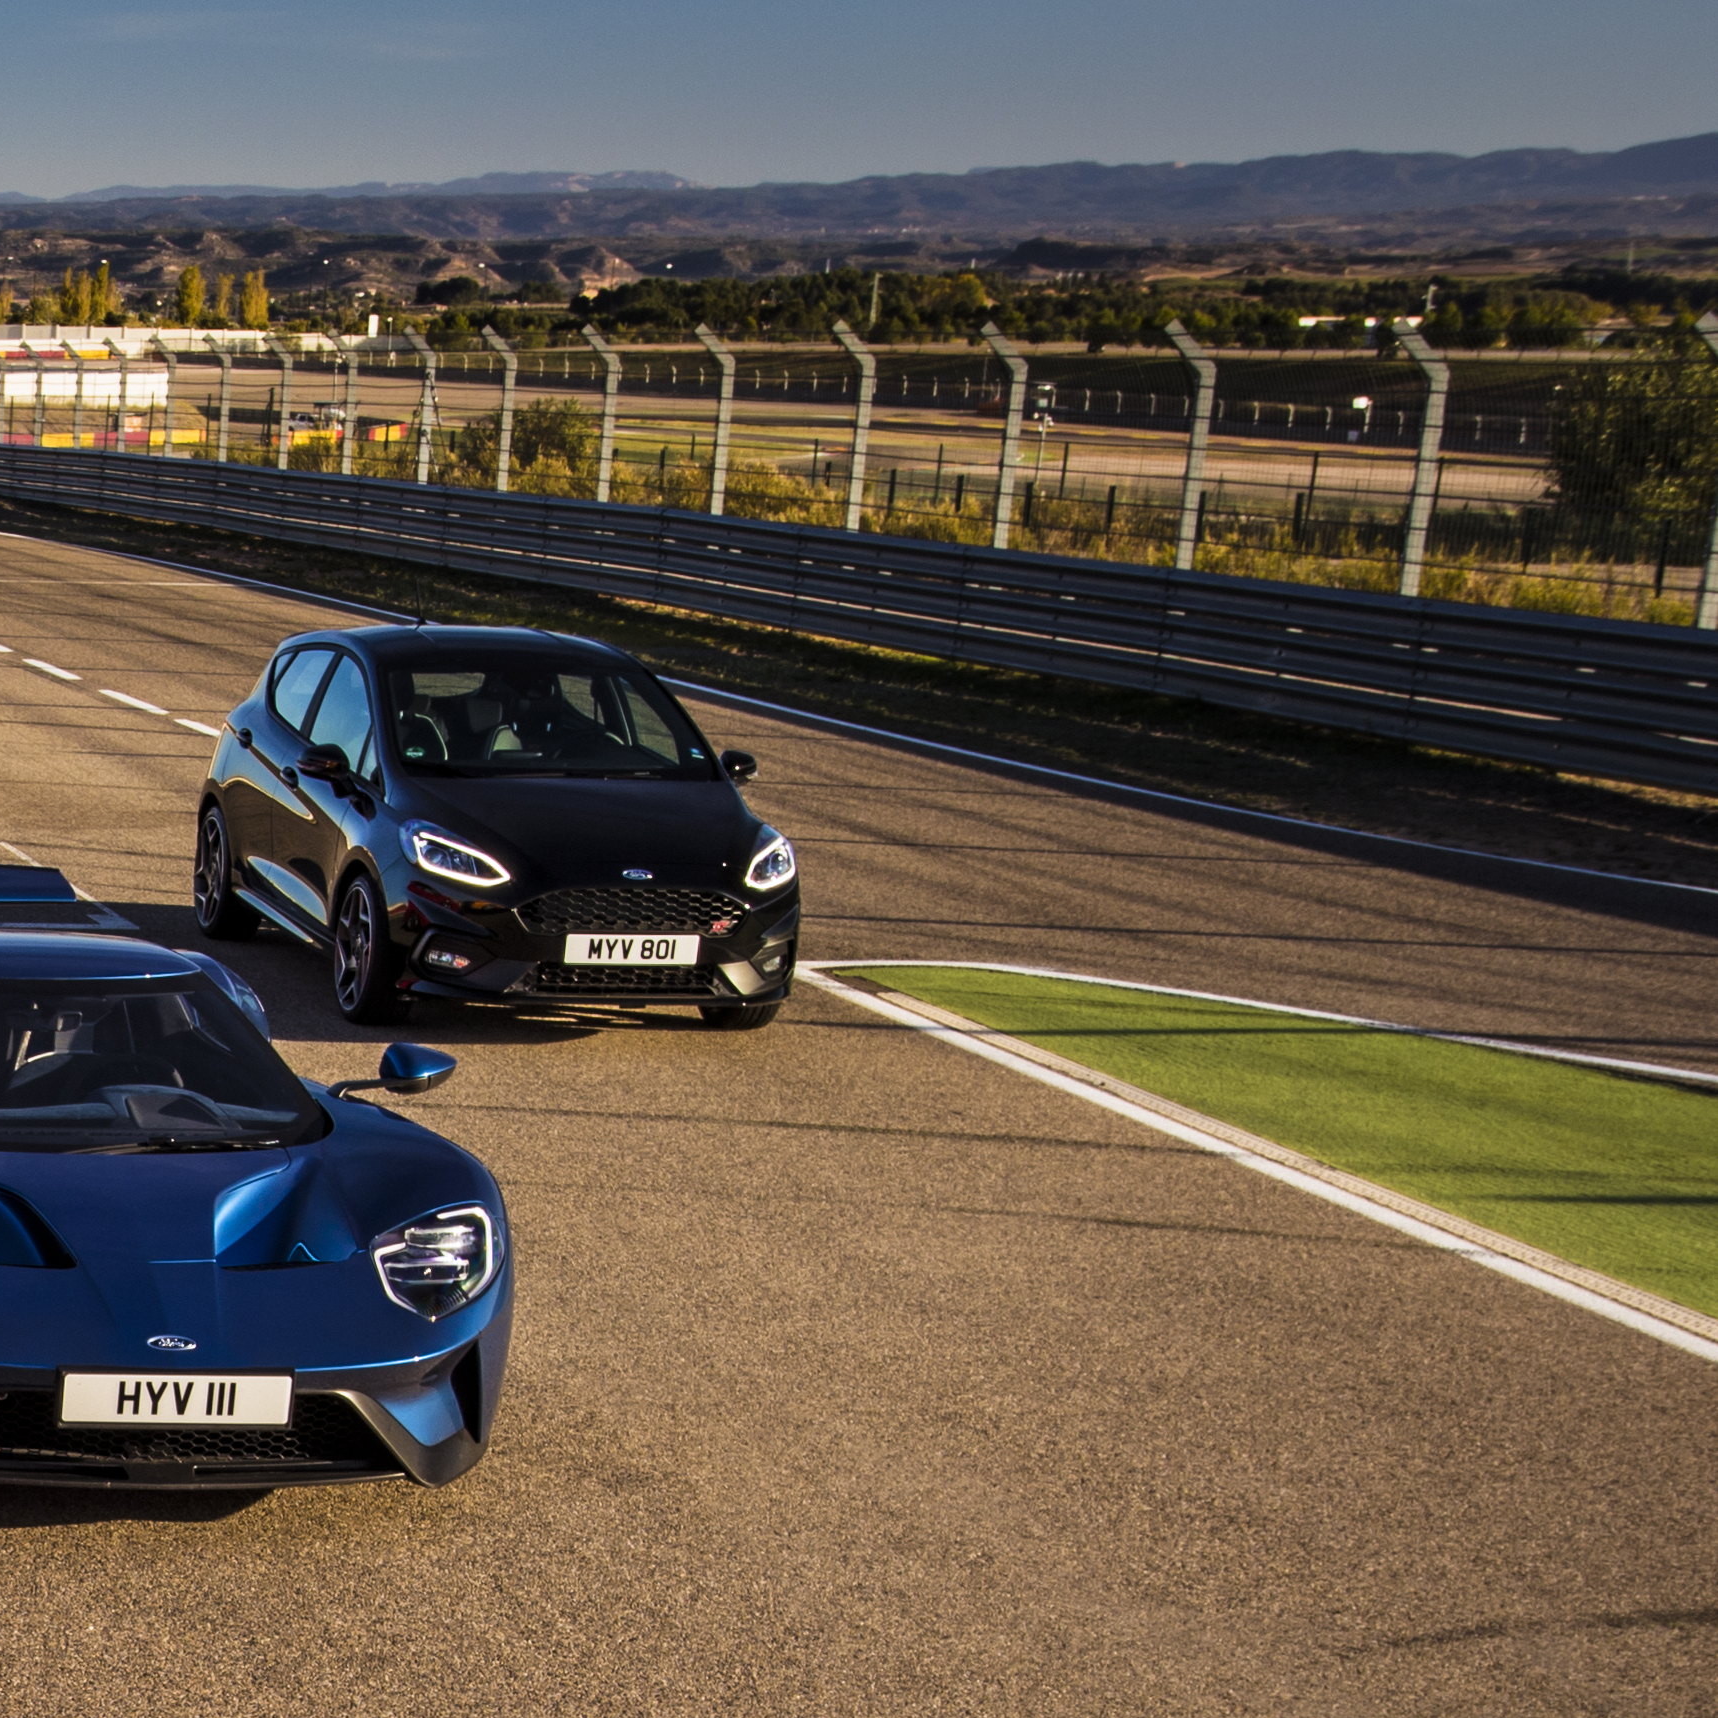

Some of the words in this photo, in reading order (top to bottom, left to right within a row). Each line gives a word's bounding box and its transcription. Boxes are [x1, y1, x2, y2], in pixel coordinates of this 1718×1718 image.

[587, 938, 634, 960] MYV
[640, 939, 677, 960] 801
[116, 1380, 195, 1415] HYV
